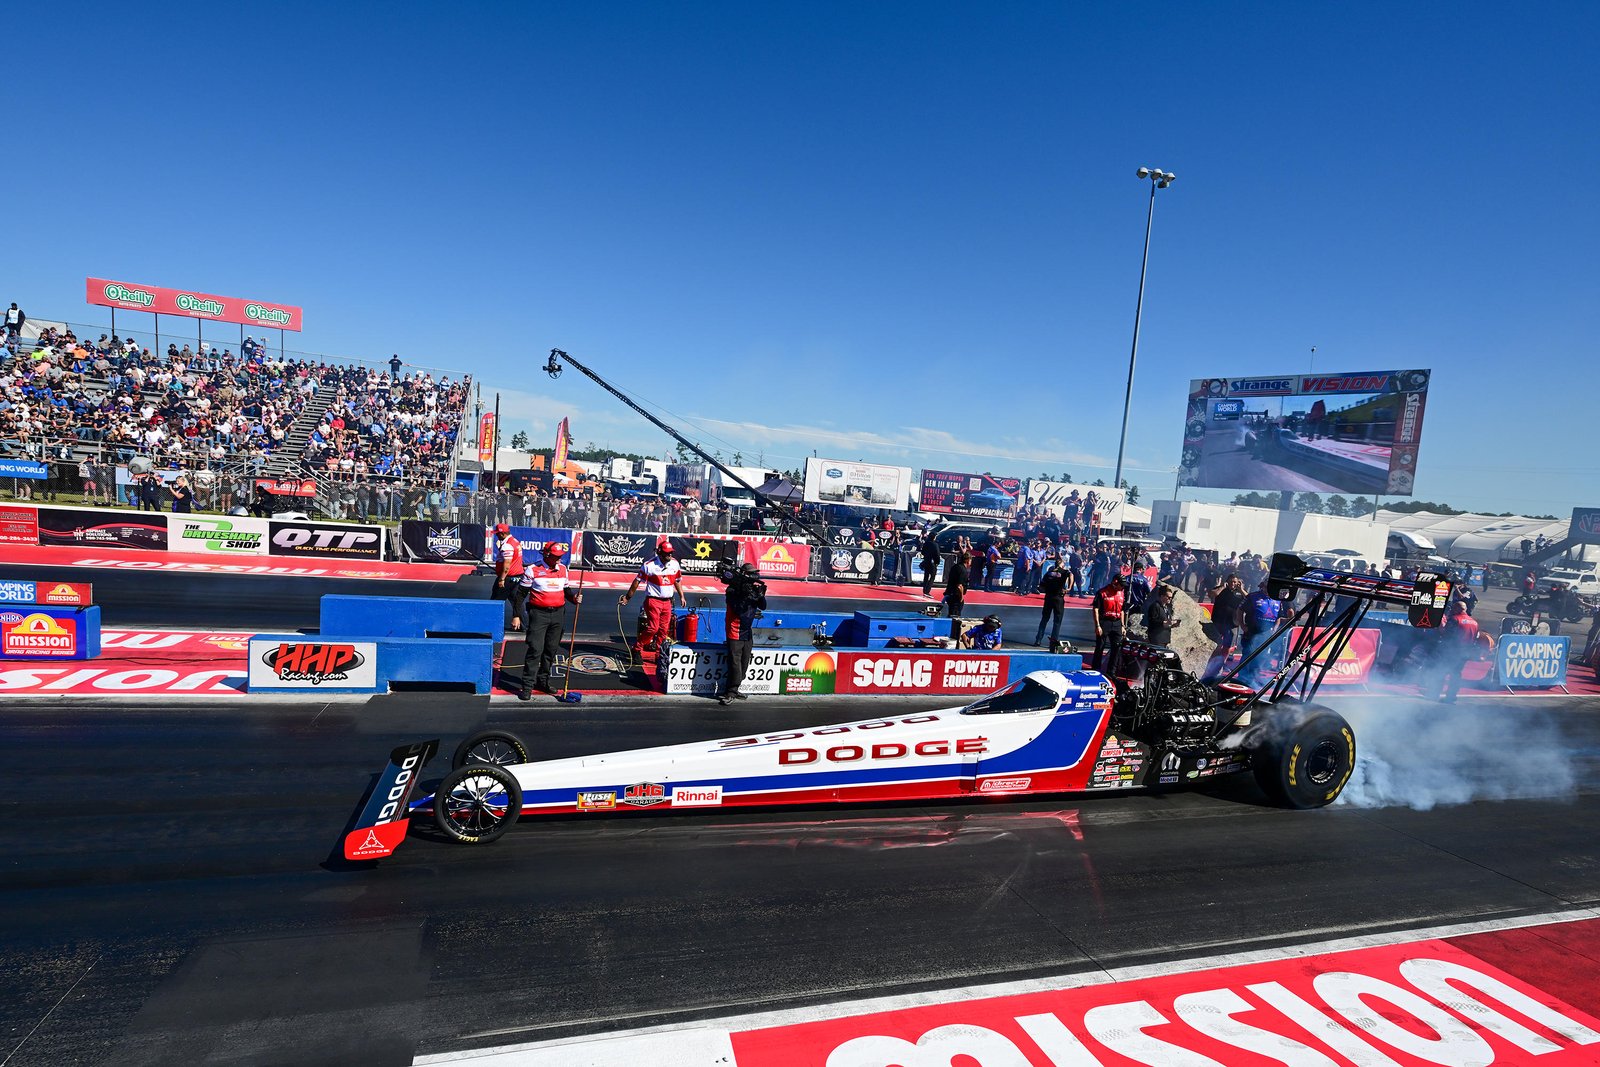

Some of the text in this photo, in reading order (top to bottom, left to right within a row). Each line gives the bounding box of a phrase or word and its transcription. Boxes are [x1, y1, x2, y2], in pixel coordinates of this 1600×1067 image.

[104, 284, 154, 306] O'Reilly
[176, 294, 224, 316] O'Reilly
[245, 304, 292, 325] O'Reilly
[1230, 379, 1290, 392] Strange
[1302, 376, 1388, 392] VISION
[1402, 393, 1420, 442] Strange
[16, 466, 45, 474] WORLD
[182, 530, 261, 541] DRIVESHAFT
[273, 528, 378, 548] QTP
[226, 540, 261, 548] SHOP
[521, 541, 541, 550] AUTO
[681, 558, 720, 568] SUNBE
[1506, 642, 1562, 660] CAMPING
[273, 644, 356, 674] HHP
[670, 652, 799, 666] Pait's Trtor LLC
[669, 668, 774, 681] 910-654320
[853, 658, 932, 687] SCAG
[945, 660, 1000, 674] POWER
[1506, 659, 1560, 678] WORLD
[280, 668, 348, 684] Racing.com
[942, 675, 998, 687] EQUIPMENT
[1172, 715, 1214, 723] HEMI
[778, 737, 987, 765] DODGE
[1289, 744, 1301, 786] EAGLE
[375, 756, 419, 826] DODG
[583, 793, 612, 802] RUSH
[626, 784, 663, 797] JHG
[677, 790, 718, 802] Rinnai
